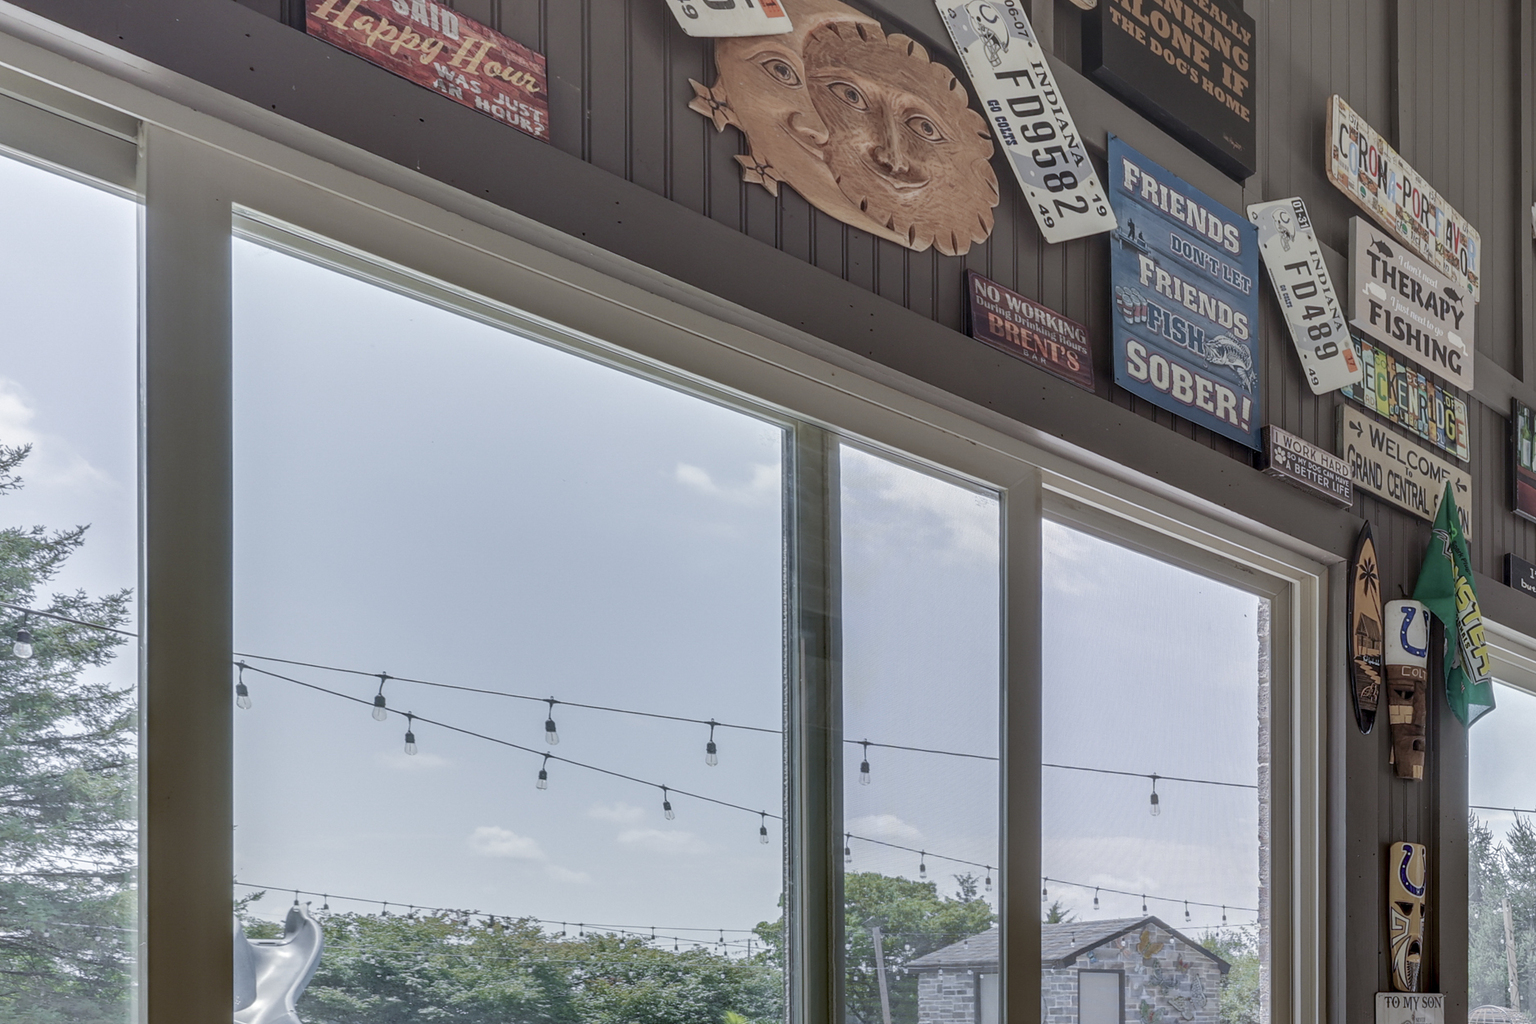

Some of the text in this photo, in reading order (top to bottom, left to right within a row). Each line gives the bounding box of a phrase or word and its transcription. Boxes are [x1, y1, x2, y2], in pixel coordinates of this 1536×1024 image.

[311, 0, 541, 94] Happy Hour
[391, 0, 461, 41] SAID
[432, 61, 544, 123] WAS JUST
[1109, 6, 1250, 122] THE DOG'S HOME
[1222, 62, 1249, 97] IF
[433, 78, 546, 137] AN HOUR?
[993, 115, 1018, 147] COLTS
[1030, 60, 1086, 168] INDIANA
[994, 69, 1091, 220] FD9582
[1037, 204, 1055, 230] 49
[1122, 157, 1241, 255] FRIENDS
[1291, 200, 1311, 230] 01-31
[1170, 232, 1252, 296] DON'T LET
[1308, 249, 1342, 332] INDIANA
[1366, 249, 1465, 331] THERAPY
[974, 278, 1086, 345] NO WORKING
[976, 295, 1088, 355] During Drinking Hours
[1138, 254, 1250, 342] FRIENDS
[1284, 260, 1339, 361] FD489
[988, 312, 1080, 372] BRENT'S
[1023, 348, 1047, 365] BAR
[1146, 300, 1206, 358] FISH
[1368, 298, 1463, 377] FISHING
[1125, 338, 1253, 435] SOBER!
[1306, 367, 1320, 386] 49
[1357, 358, 1466, 450] ECKENRIDGE
[1283, 433, 1350, 478] WORK HARD
[1294, 461, 1351, 499] BETTER LIFE
[1308, 460, 1350, 488] DOG CAN HAVE
[1346, 443, 1384, 492] GRAND
[1387, 468, 1431, 516] CENTRAL
[1369, 423, 1452, 485] WELCOME
[1521, 578, 1536, 593] but
[1401, 665, 1428, 679] COLT
[1384, 995, 1443, 1011] TO MY SON
